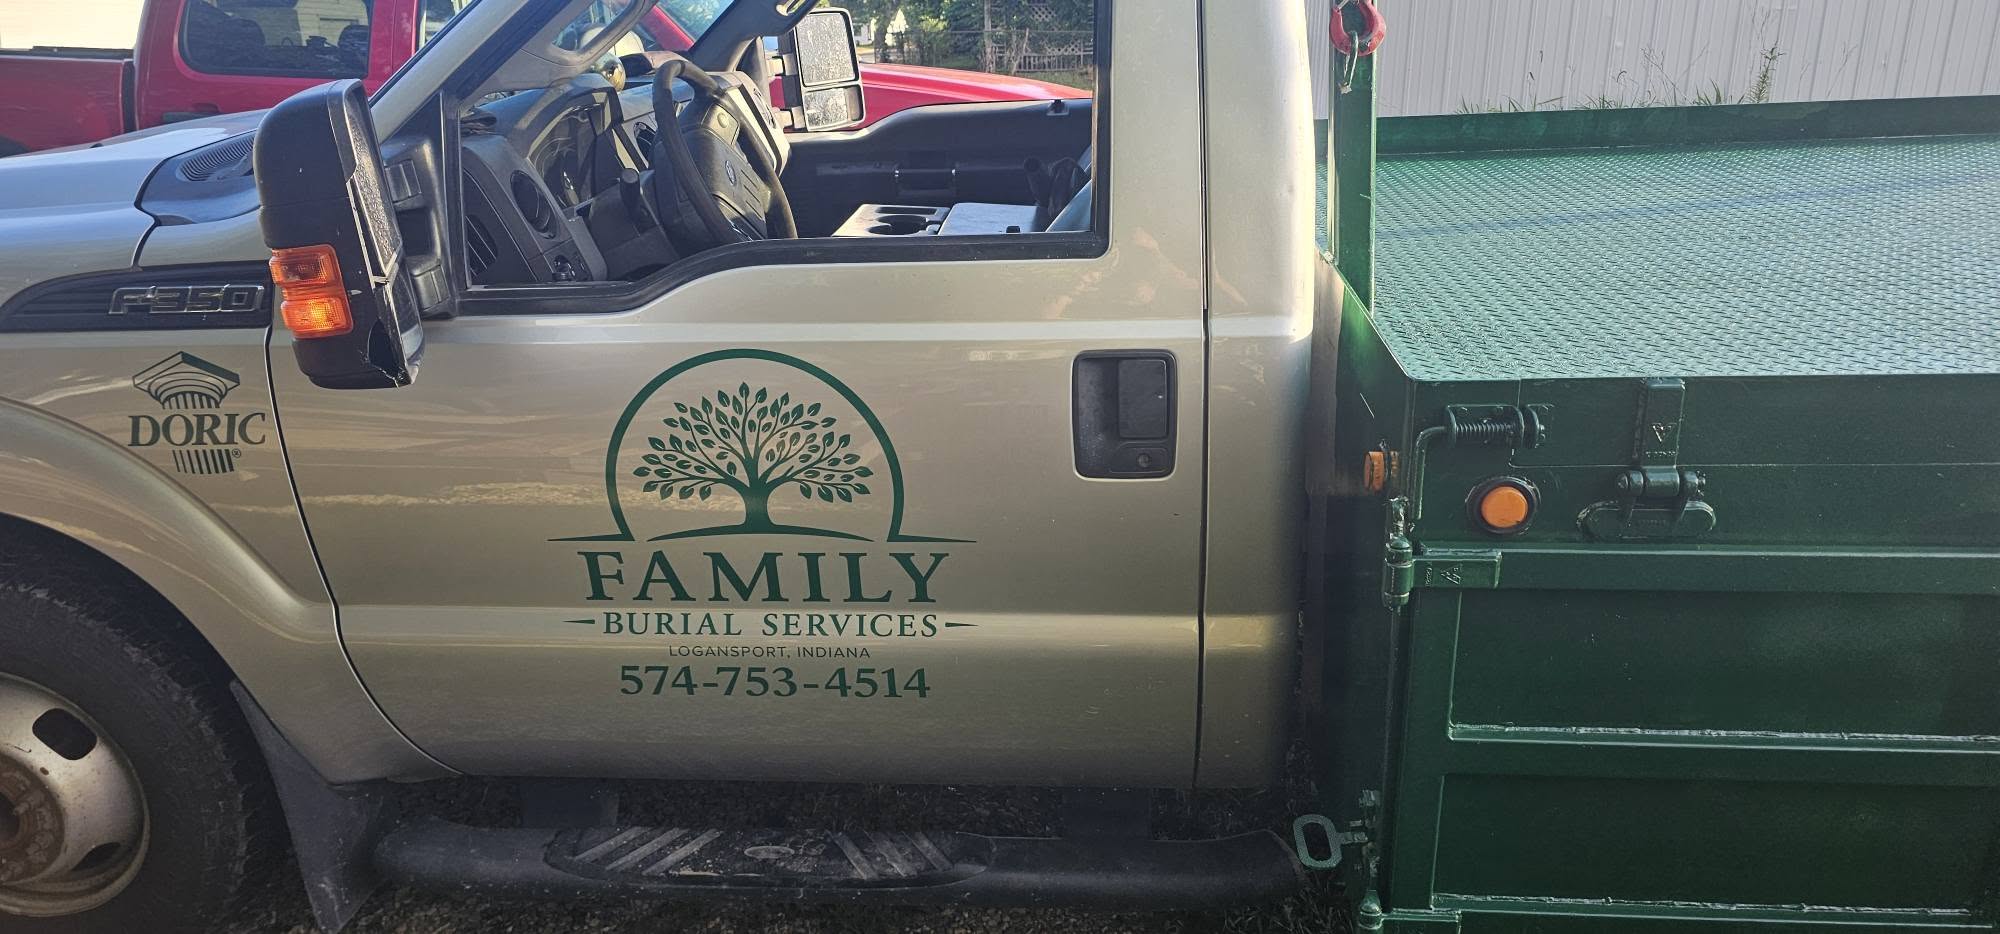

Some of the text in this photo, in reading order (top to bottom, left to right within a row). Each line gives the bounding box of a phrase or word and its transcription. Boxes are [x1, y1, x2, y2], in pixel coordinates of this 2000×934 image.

[128, 412, 266, 447] DORIC
[577, 550, 950, 603] FAMILY
[603, 611, 938, 638] BURIAL SERVICES
[668, 645, 871, 659] LOGANSPORT, INDIANA
[620, 664, 931, 699] 574-753-4514
